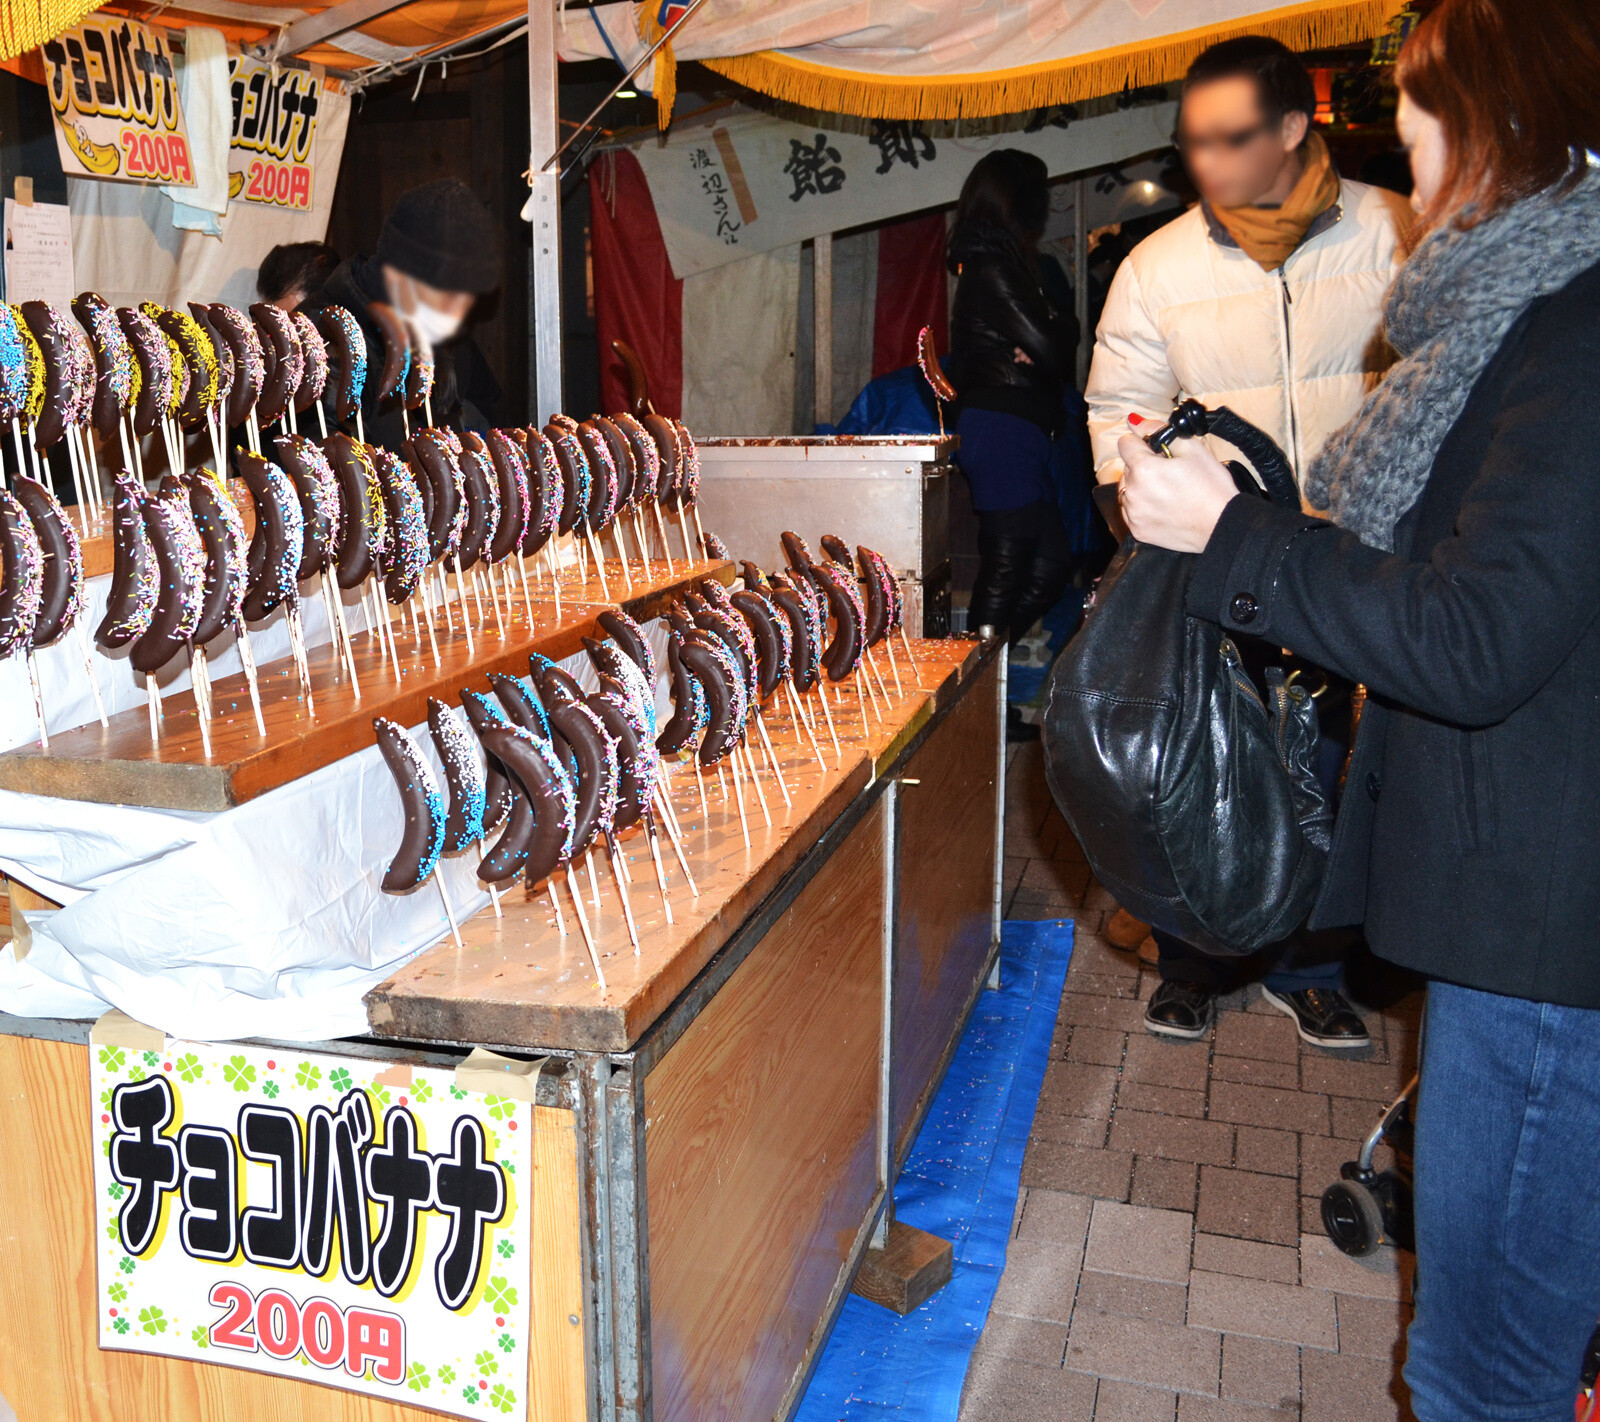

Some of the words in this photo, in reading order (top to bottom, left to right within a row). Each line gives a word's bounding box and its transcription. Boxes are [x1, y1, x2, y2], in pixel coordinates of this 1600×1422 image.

[42, 21, 176, 124] チョコバナナ
[228, 58, 318, 153] ョコバナナ
[122, 131, 192, 182] 200円
[247, 161, 311, 207] 200円
[110, 1075, 505, 1310] チョコバナナ
[208, 1280, 406, 1386] 200円
